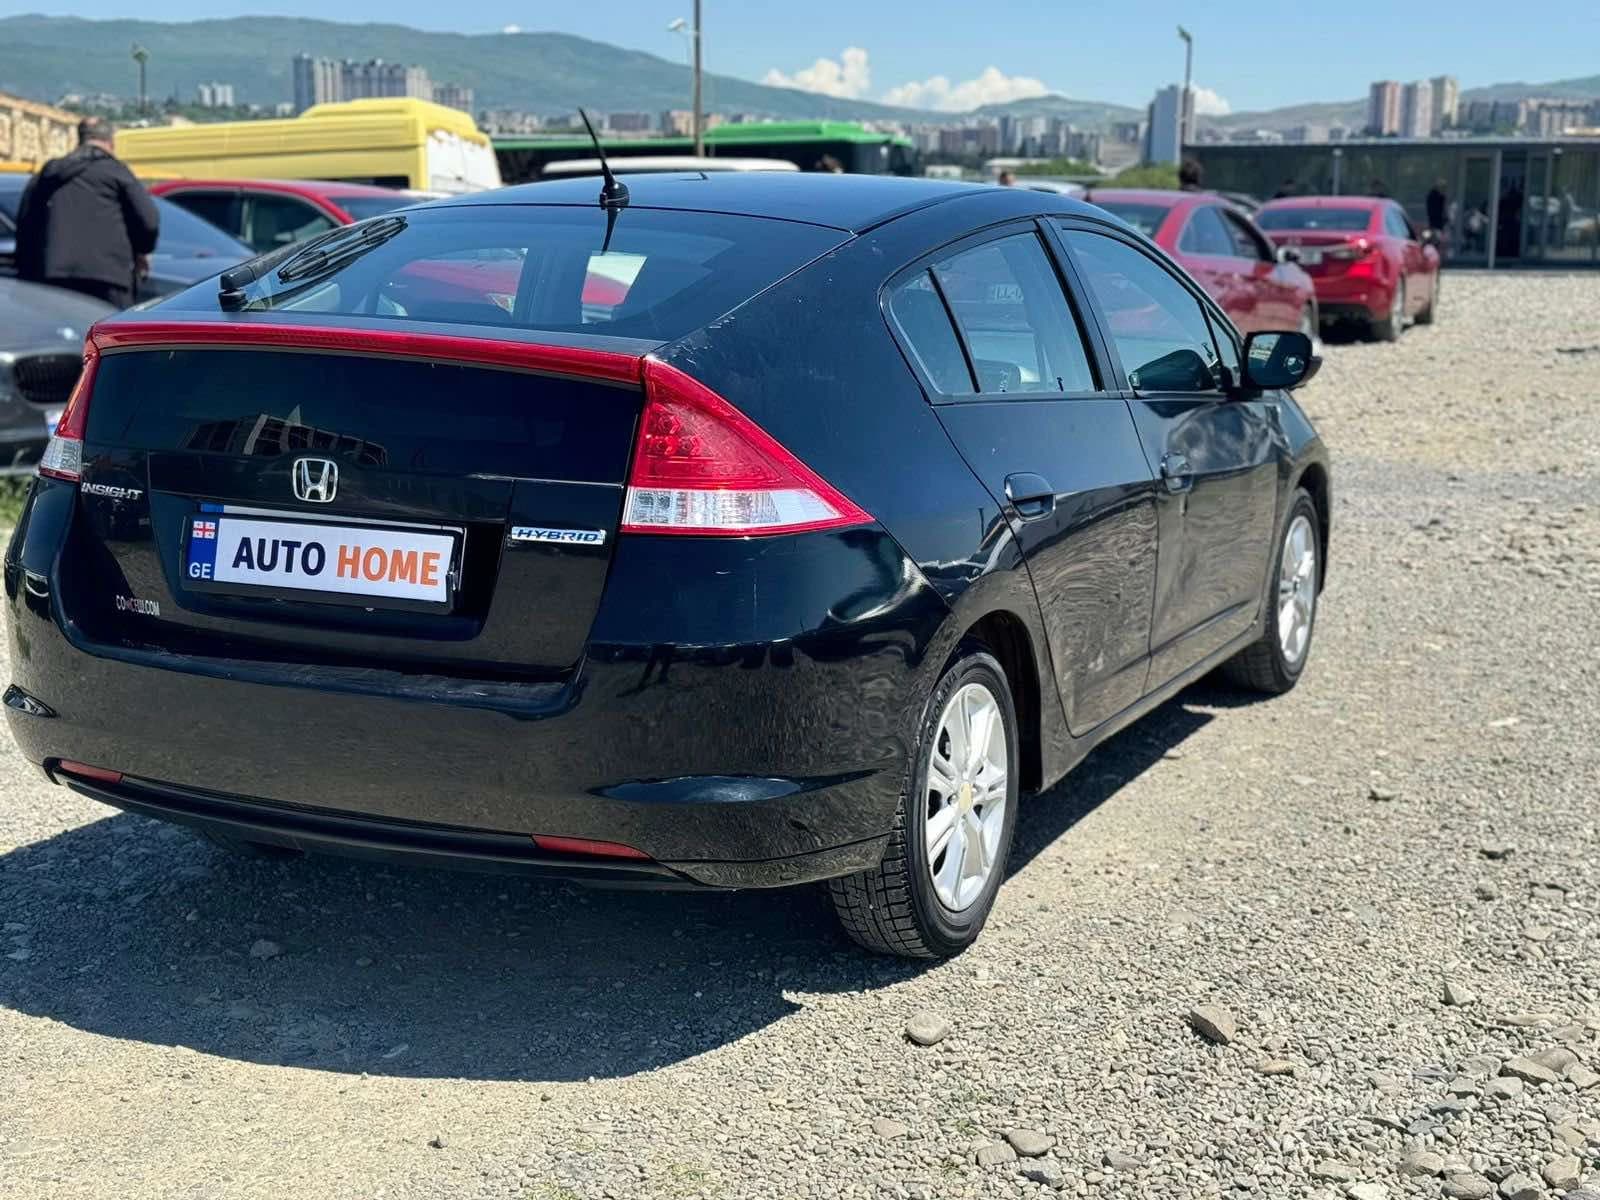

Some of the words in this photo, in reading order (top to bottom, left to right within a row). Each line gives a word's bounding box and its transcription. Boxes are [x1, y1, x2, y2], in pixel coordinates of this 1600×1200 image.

[81, 482, 143, 500] INSIGHT
[517, 529, 600, 541] HYBRID
[232, 536, 326, 576] AUTO
[336, 545, 441, 586] HOME
[189, 562, 211, 579] GE
